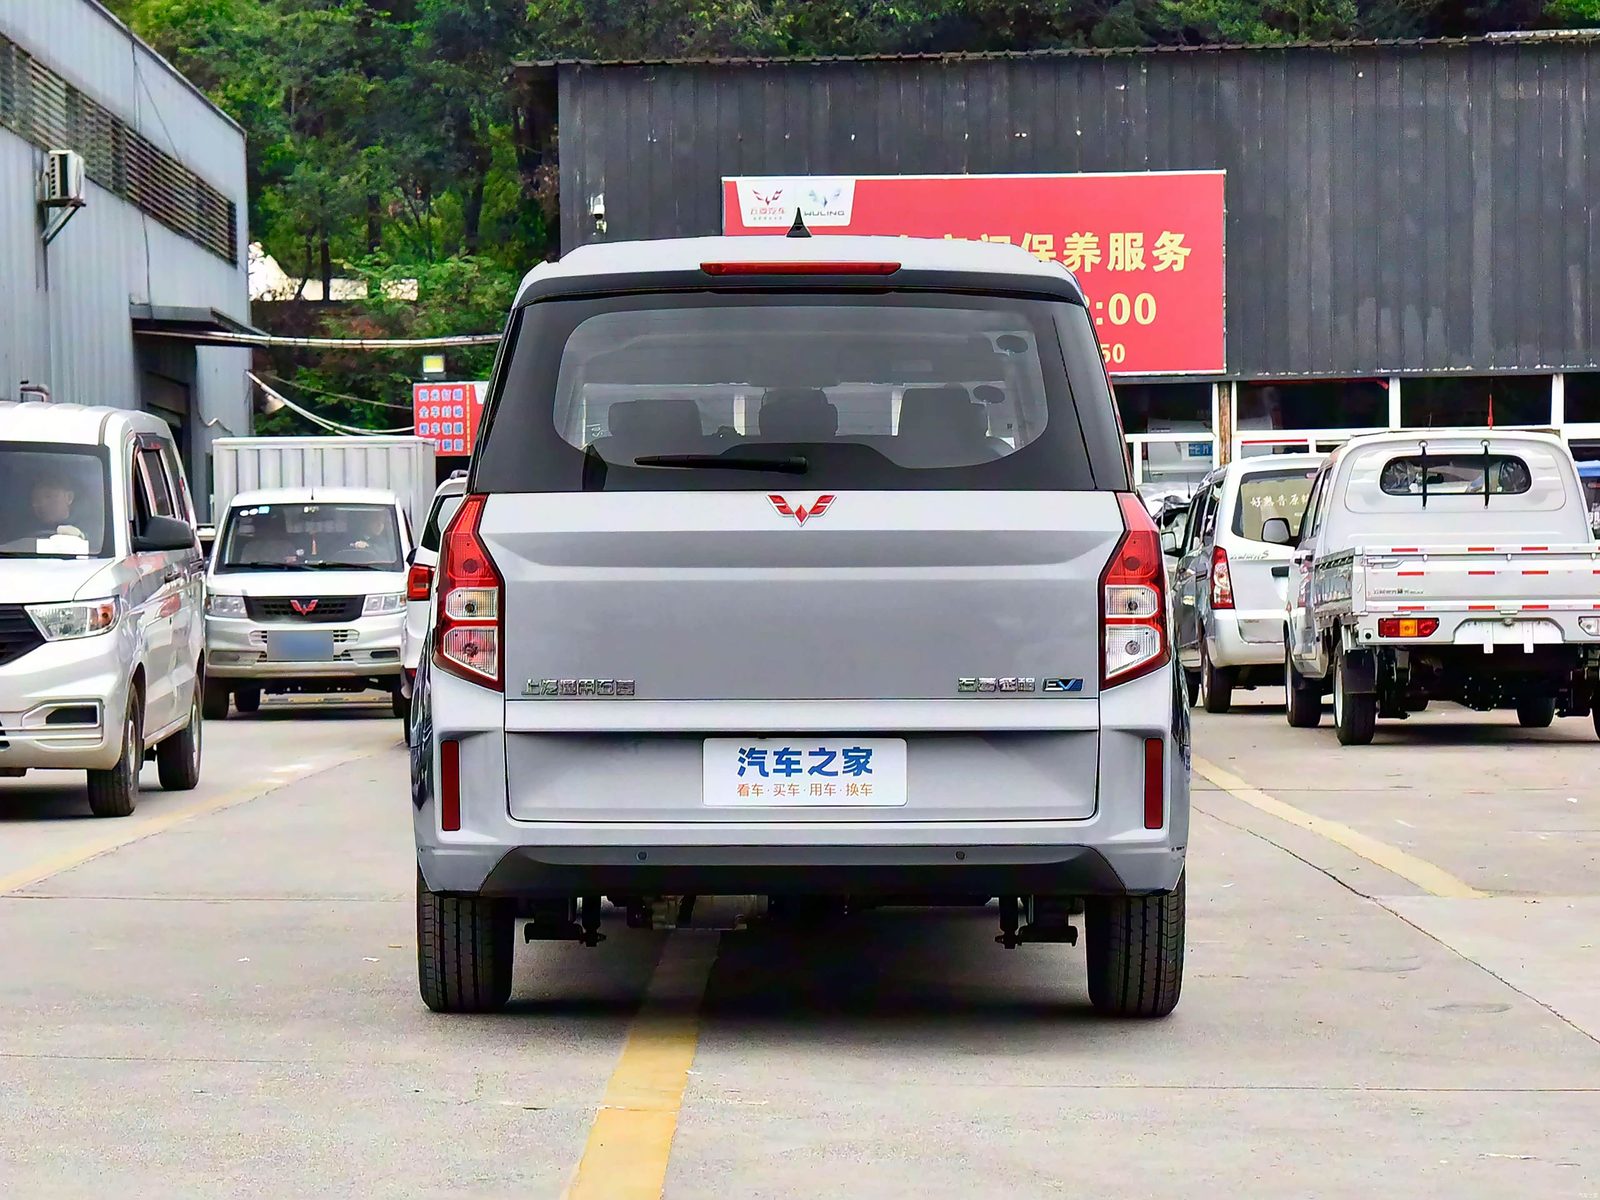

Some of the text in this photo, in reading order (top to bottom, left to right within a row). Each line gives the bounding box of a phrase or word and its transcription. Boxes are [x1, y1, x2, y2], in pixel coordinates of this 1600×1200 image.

[804, 209, 846, 217] WULING
[943, 230, 1192, 273] 保养服务
[1085, 292, 1158, 326] :00
[520, 678, 636, 696] 上汽通用五菱
[1042, 678, 1084, 692] EV
[737, 746, 874, 778] 汽车之家
